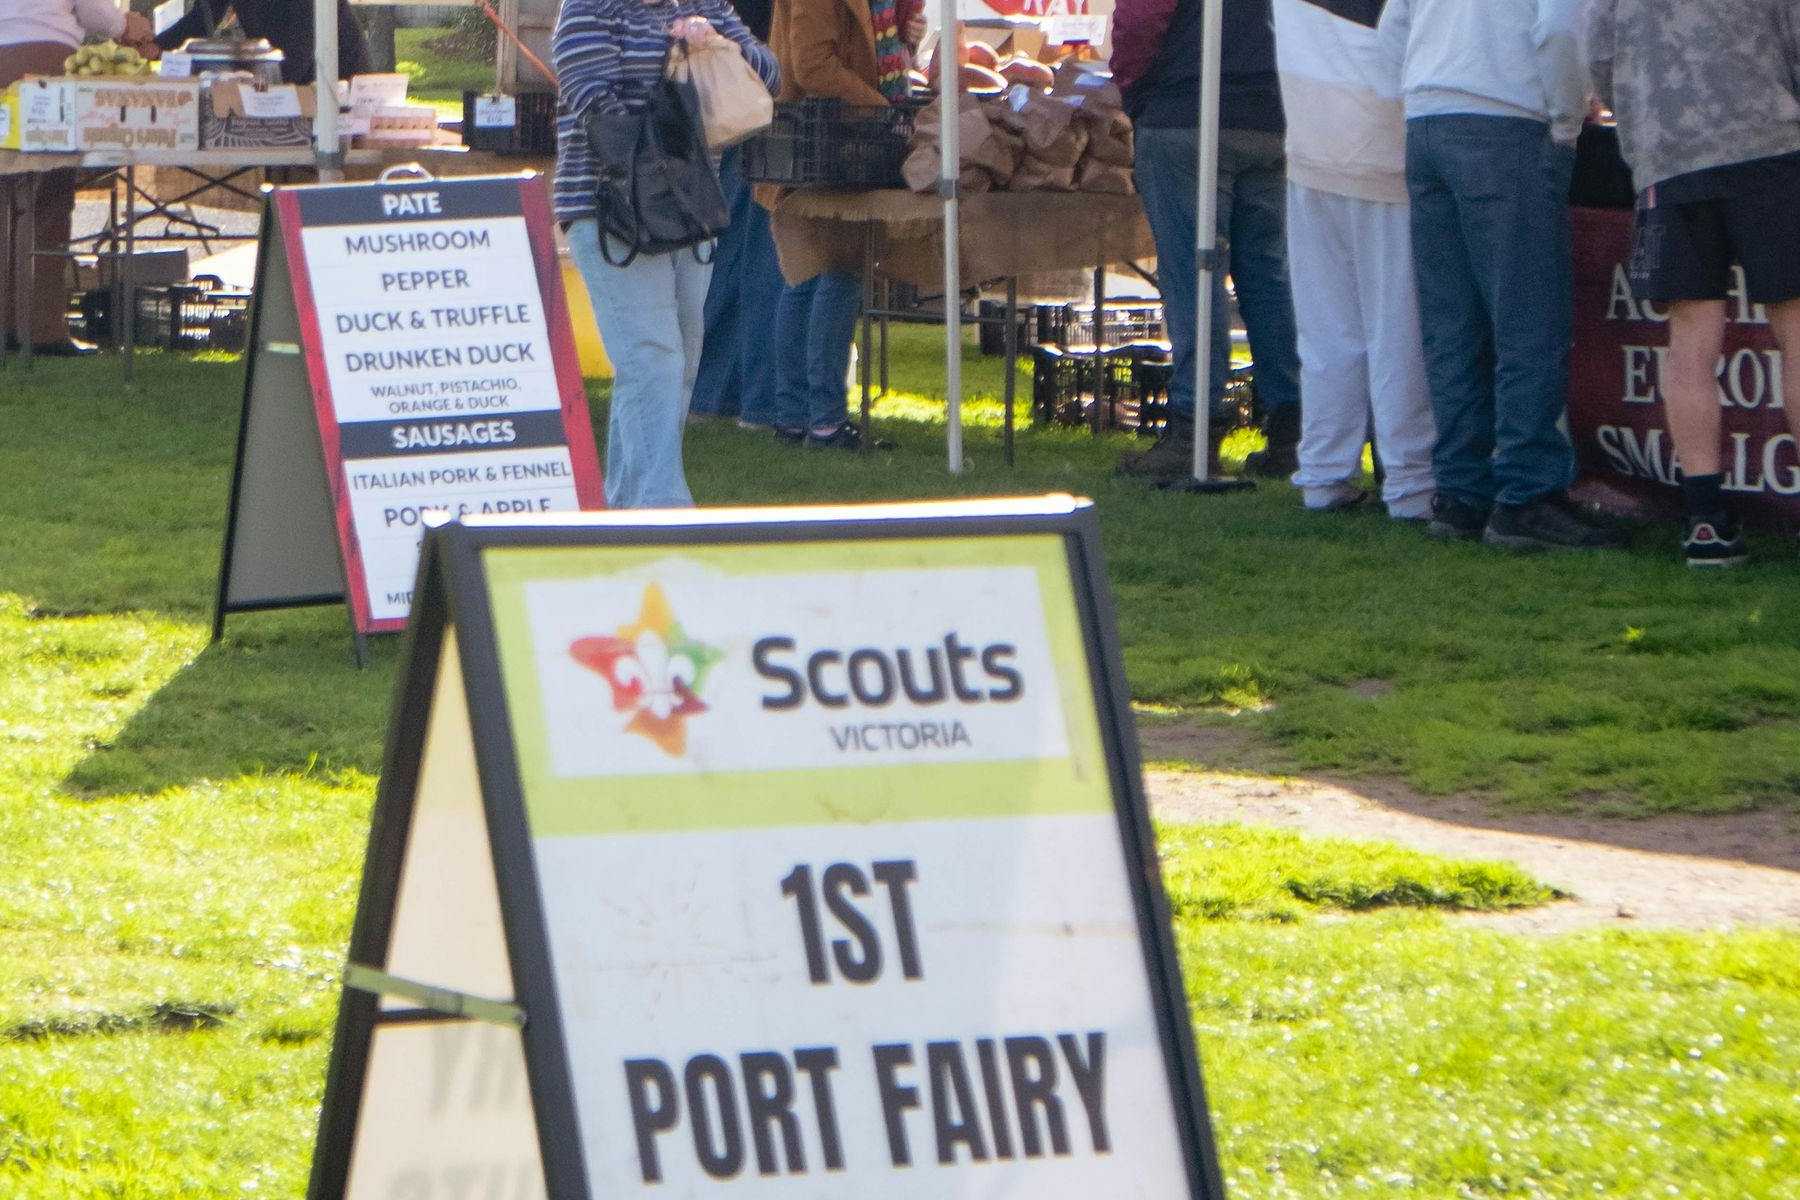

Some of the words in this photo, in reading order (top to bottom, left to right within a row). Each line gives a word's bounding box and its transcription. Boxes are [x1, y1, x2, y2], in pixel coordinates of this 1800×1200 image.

[382, 191, 442, 216] PATE
[346, 230, 491, 255] MUSHROOM
[382, 269, 470, 292] PEPPER
[336, 311, 404, 333] DUCK
[410, 310, 426, 329] &
[430, 304, 531, 328] TRUFFLE
[345, 347, 463, 372] DRUNKEN
[468, 343, 535, 365] DUCK
[371, 382, 439, 398] WALNUT,
[440, 377, 522, 394] PISTACHIO,
[388, 399, 450, 414] ORANGE
[454, 399, 465, 410] &
[468, 395, 510, 409] DUCK
[392, 418, 517, 449] SAUSAGES
[352, 471, 425, 490] ITALIAN
[430, 467, 481, 486] PORK
[486, 466, 497, 482] &
[502, 461, 572, 480] FENNEL
[751, 632, 1024, 712] Scouts
[829, 720, 972, 753] VICTORIA
[781, 859, 927, 987] 1ST
[624, 1047, 848, 1185] PORT
[871, 1032, 1114, 1168] FAIRY
